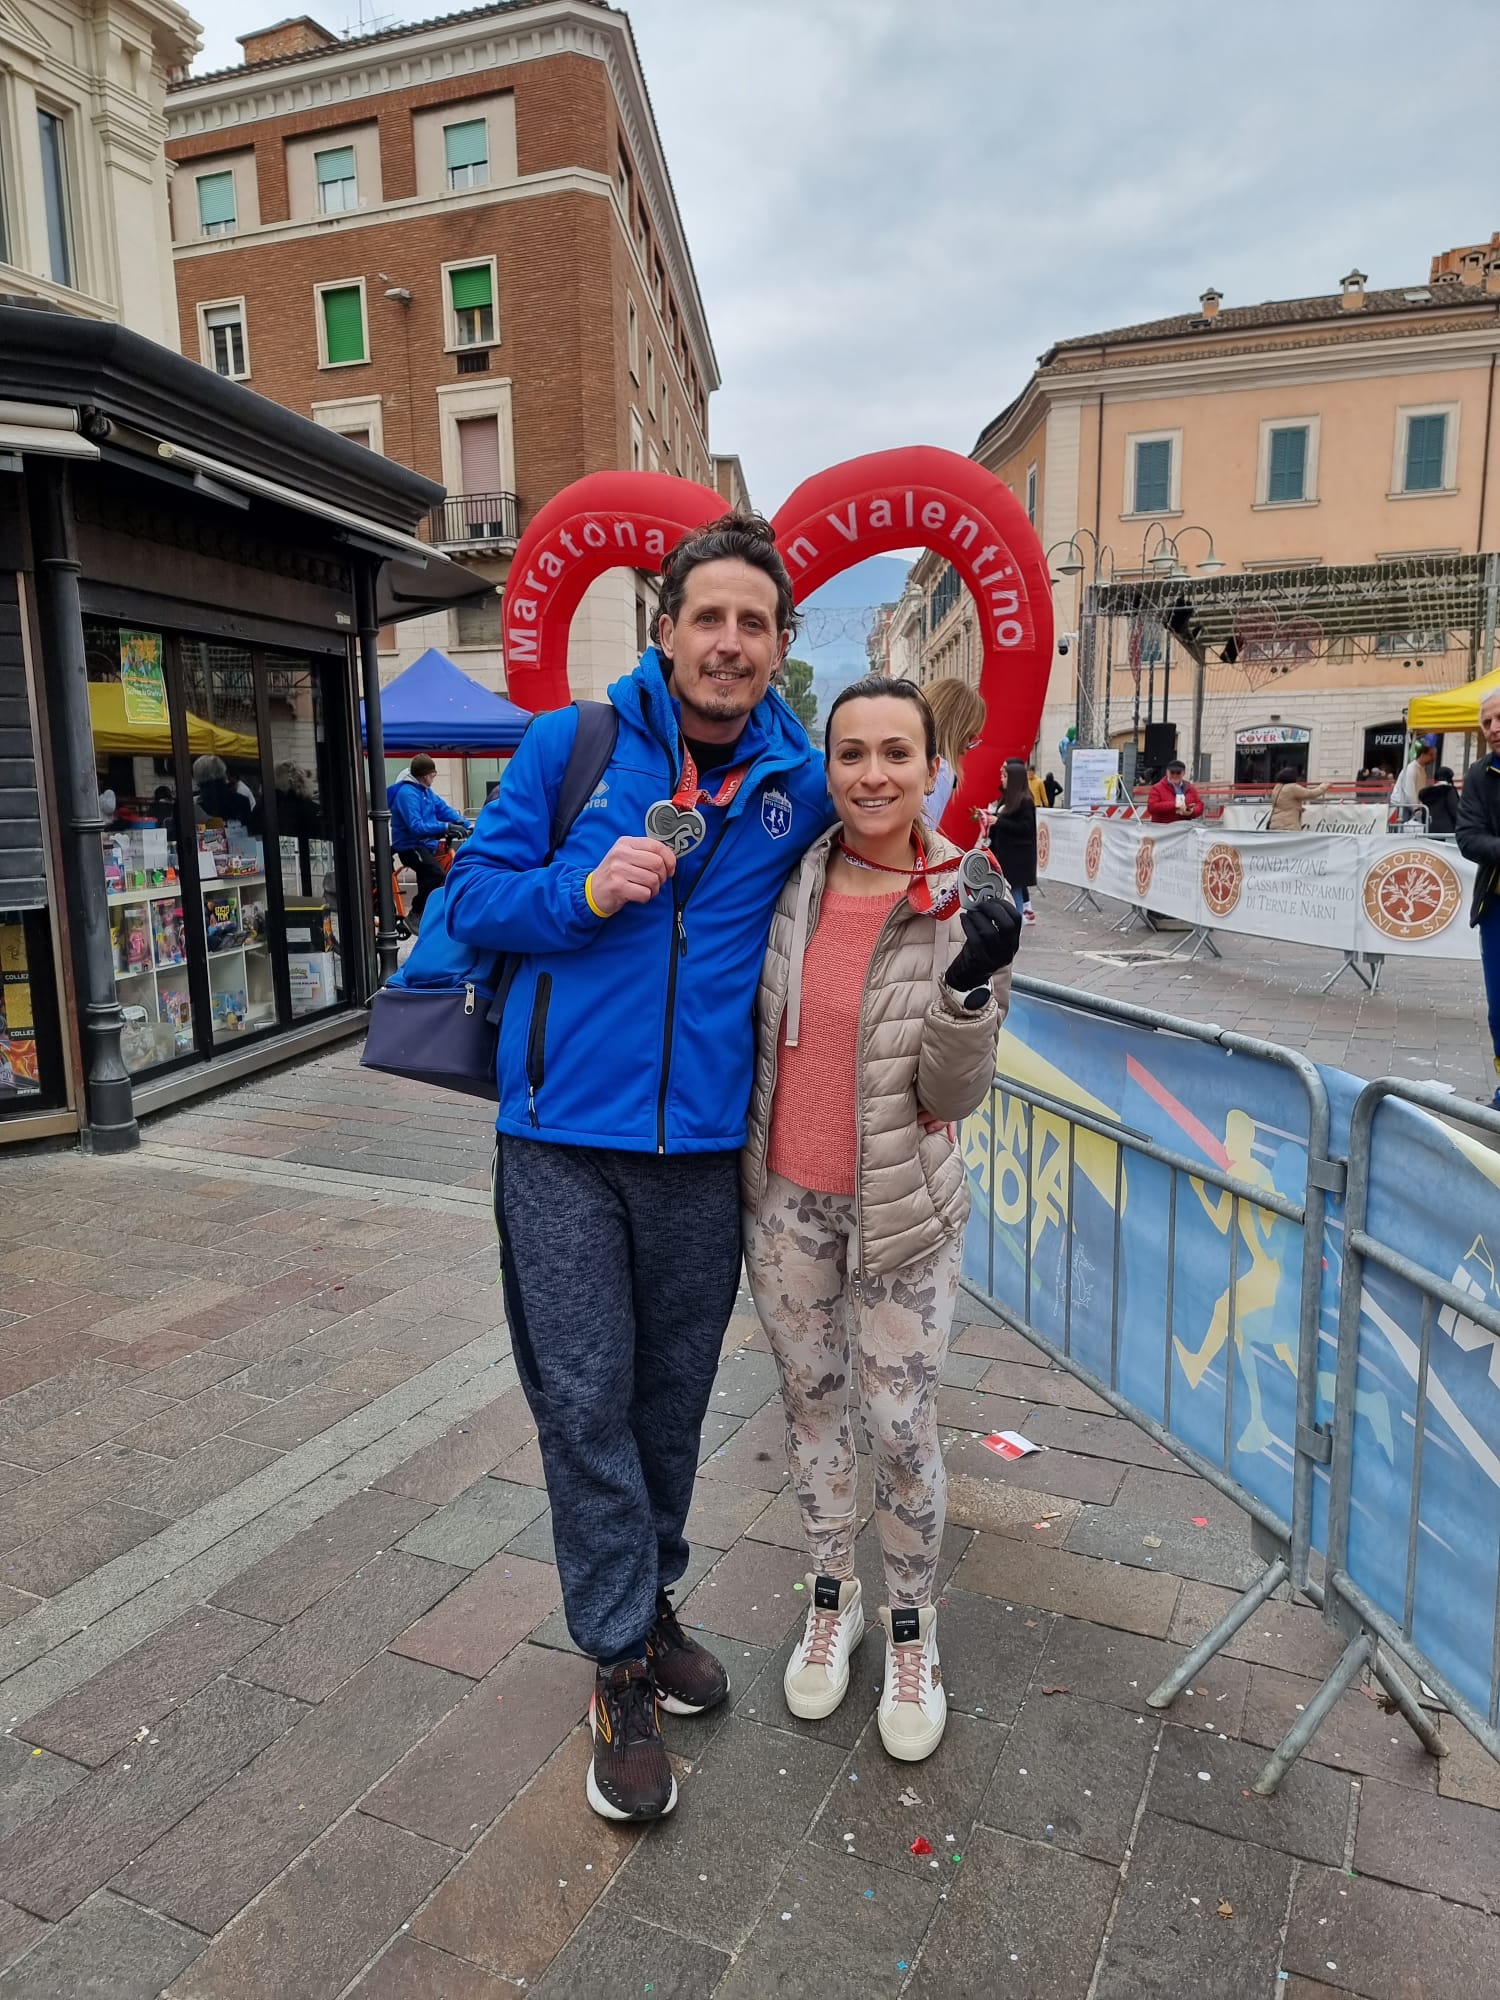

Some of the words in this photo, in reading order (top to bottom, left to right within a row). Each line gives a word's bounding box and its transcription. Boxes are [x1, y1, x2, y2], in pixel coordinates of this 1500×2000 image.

[509, 520, 665, 662] Maratona
[827, 490, 1025, 647] Valentino
[1238, 735, 1277, 743] COVER
[1315, 818, 1376, 835] fisiomed
[1249, 855, 1328, 876] FONDAZIONE
[1366, 852, 1437, 907] LABORE
[1294, 881, 1354, 902] RISPARMIO
[1256, 895, 1288, 914] TERNI
[1299, 902, 1336, 921] NARNI
[1371, 912, 1393, 932] IN
